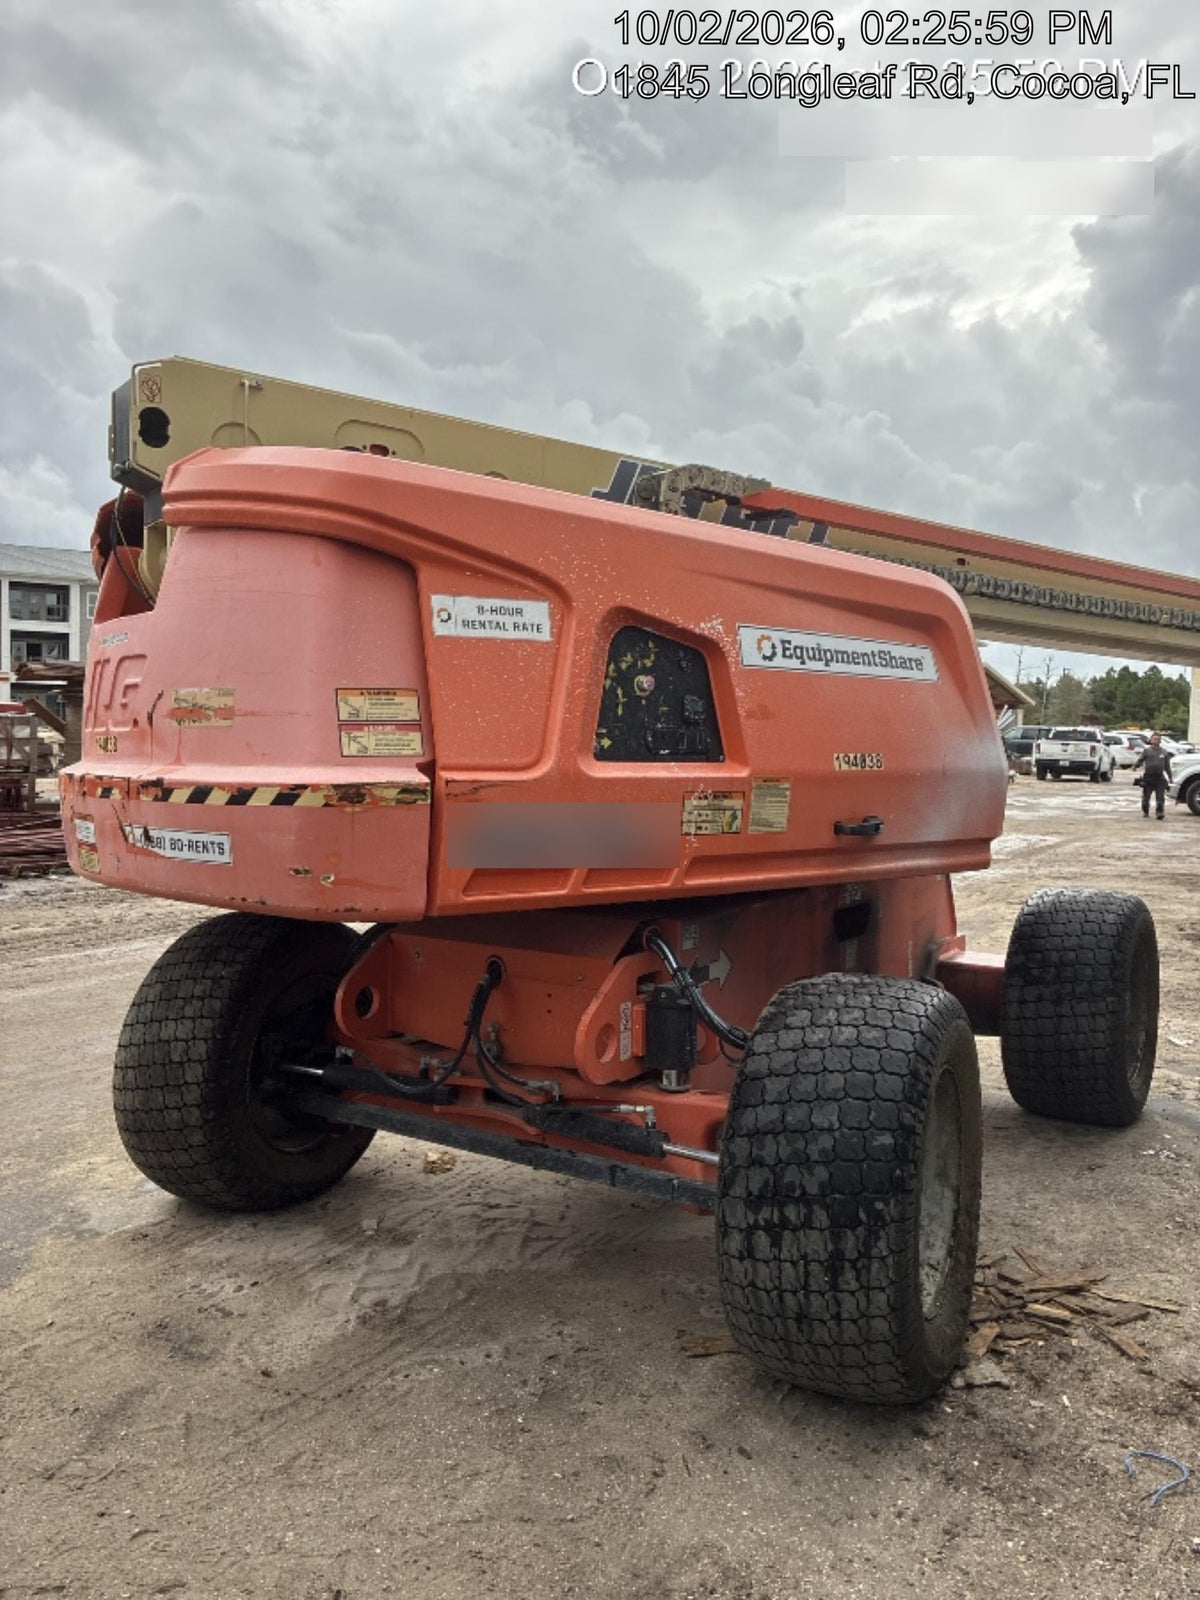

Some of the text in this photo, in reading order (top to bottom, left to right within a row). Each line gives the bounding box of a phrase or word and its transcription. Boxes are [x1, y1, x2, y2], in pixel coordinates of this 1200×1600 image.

[476, 605, 524, 618] 8-HOUR
[462, 619, 544, 634] RENTAL RATE
[780, 639, 925, 672] EquipmentShare
